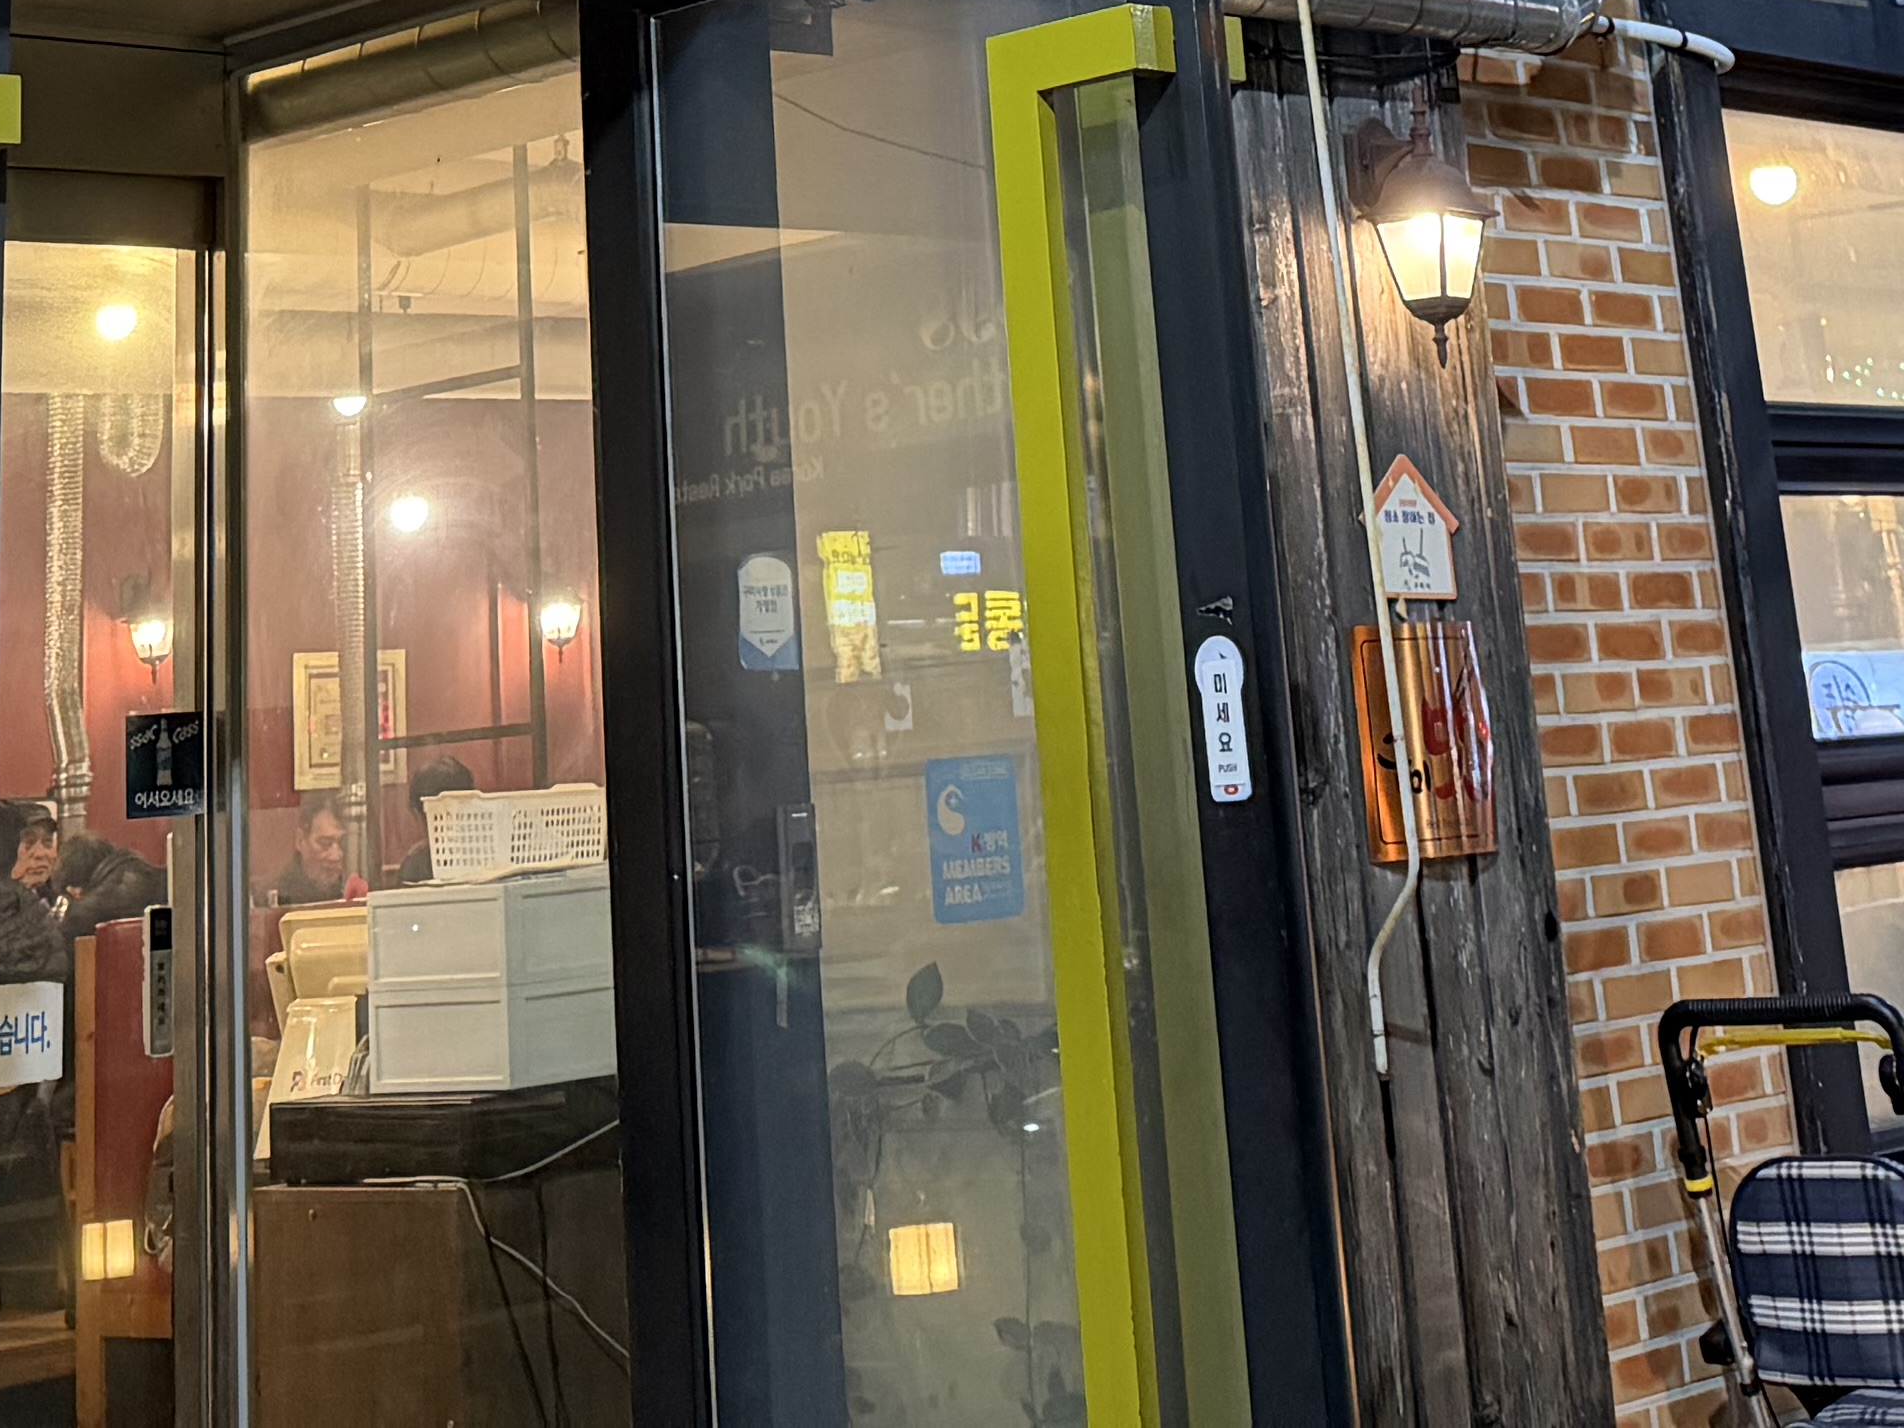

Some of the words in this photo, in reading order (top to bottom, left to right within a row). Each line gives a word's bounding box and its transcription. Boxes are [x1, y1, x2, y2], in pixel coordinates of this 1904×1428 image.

[1213, 672, 1233, 752] 미세요
[134, 787, 194, 809] 어서오세요
[944, 882, 982, 905] AREA
